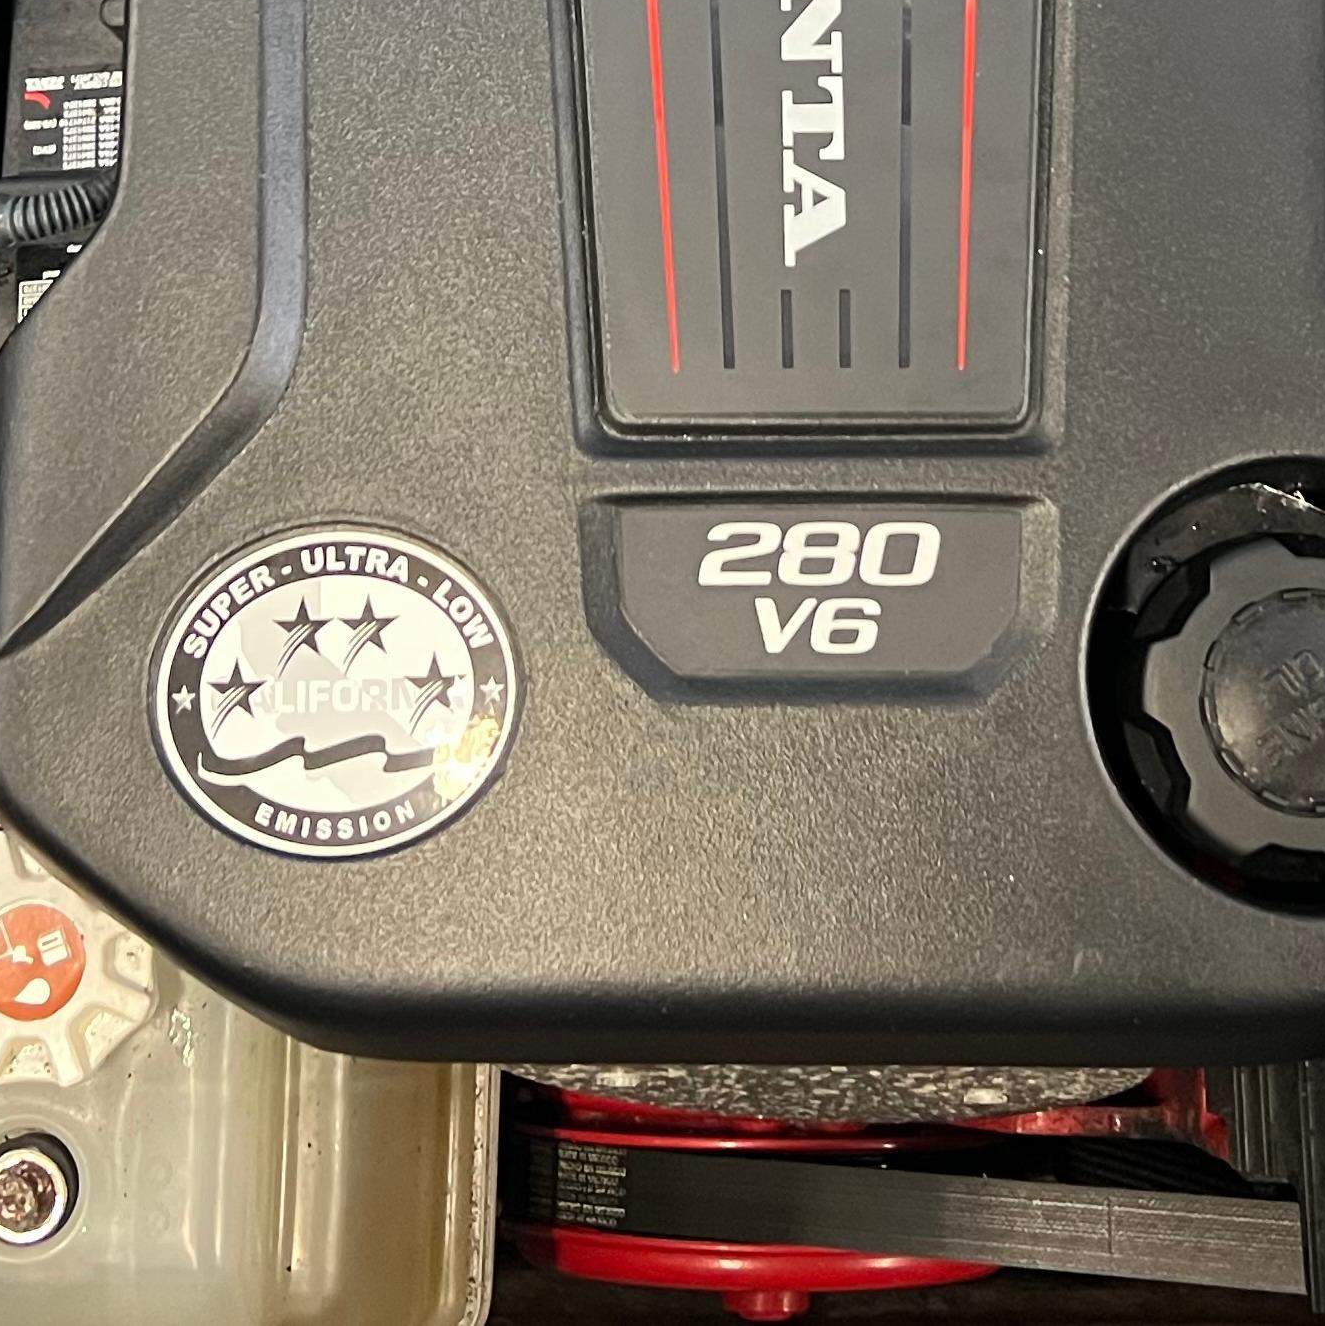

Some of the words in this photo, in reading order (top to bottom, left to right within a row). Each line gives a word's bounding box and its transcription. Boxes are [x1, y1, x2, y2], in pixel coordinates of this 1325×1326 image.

[697, 521, 942, 586] 280
[182, 563, 276, 659] SUPER
[299, 544, 410, 583] ULTRA
[431, 579, 495, 650] LOW
[754, 597, 883, 654] V6
[253, 799, 416, 841] EMISSION
